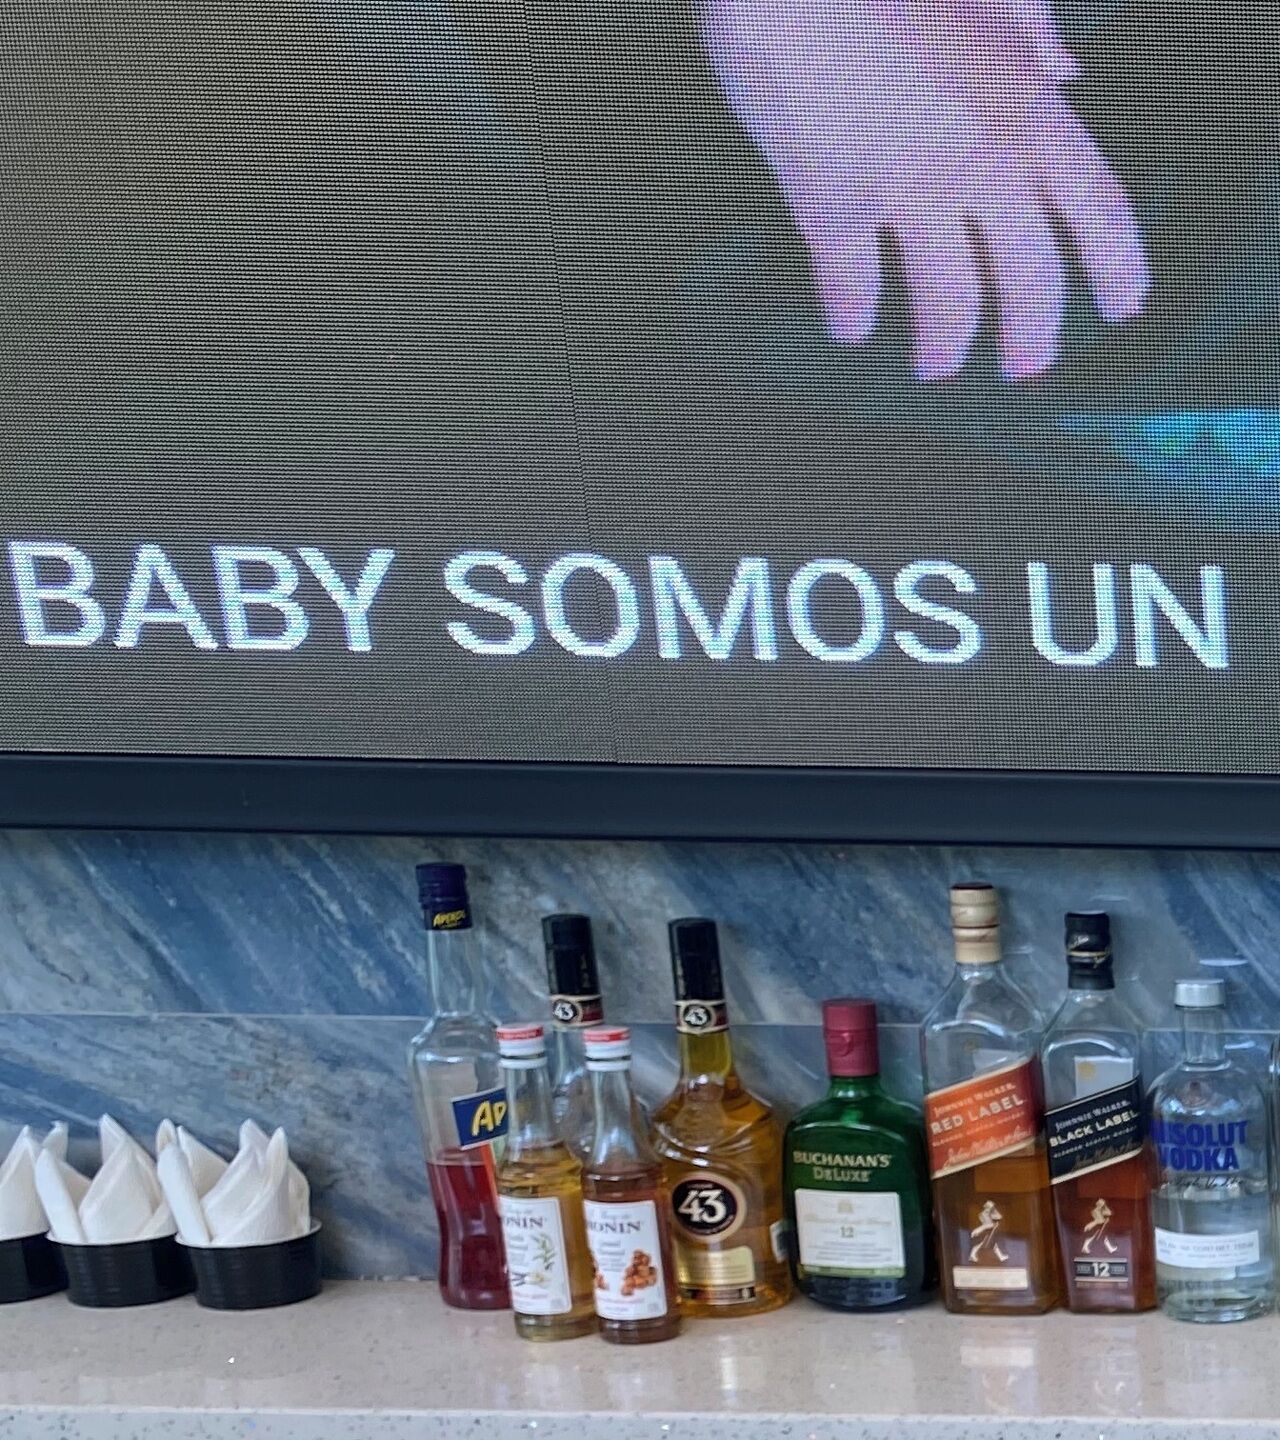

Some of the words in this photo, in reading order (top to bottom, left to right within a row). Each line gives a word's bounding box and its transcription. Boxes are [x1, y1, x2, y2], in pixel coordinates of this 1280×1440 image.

[6, 541, 395, 654] BABY
[443, 551, 984, 665] SOMOS
[1026, 560, 1230, 672] UN
[930, 1114, 964, 1136] RED
[967, 1094, 1024, 1121] LABEL
[1049, 1124, 1094, 1147] BLACK
[1094, 1109, 1138, 1131] LABEL
[792, 1150, 890, 1168] BUCHANAN'S
[678, 1189, 727, 1224] 43
[1091, 1262, 1111, 1277] 12
